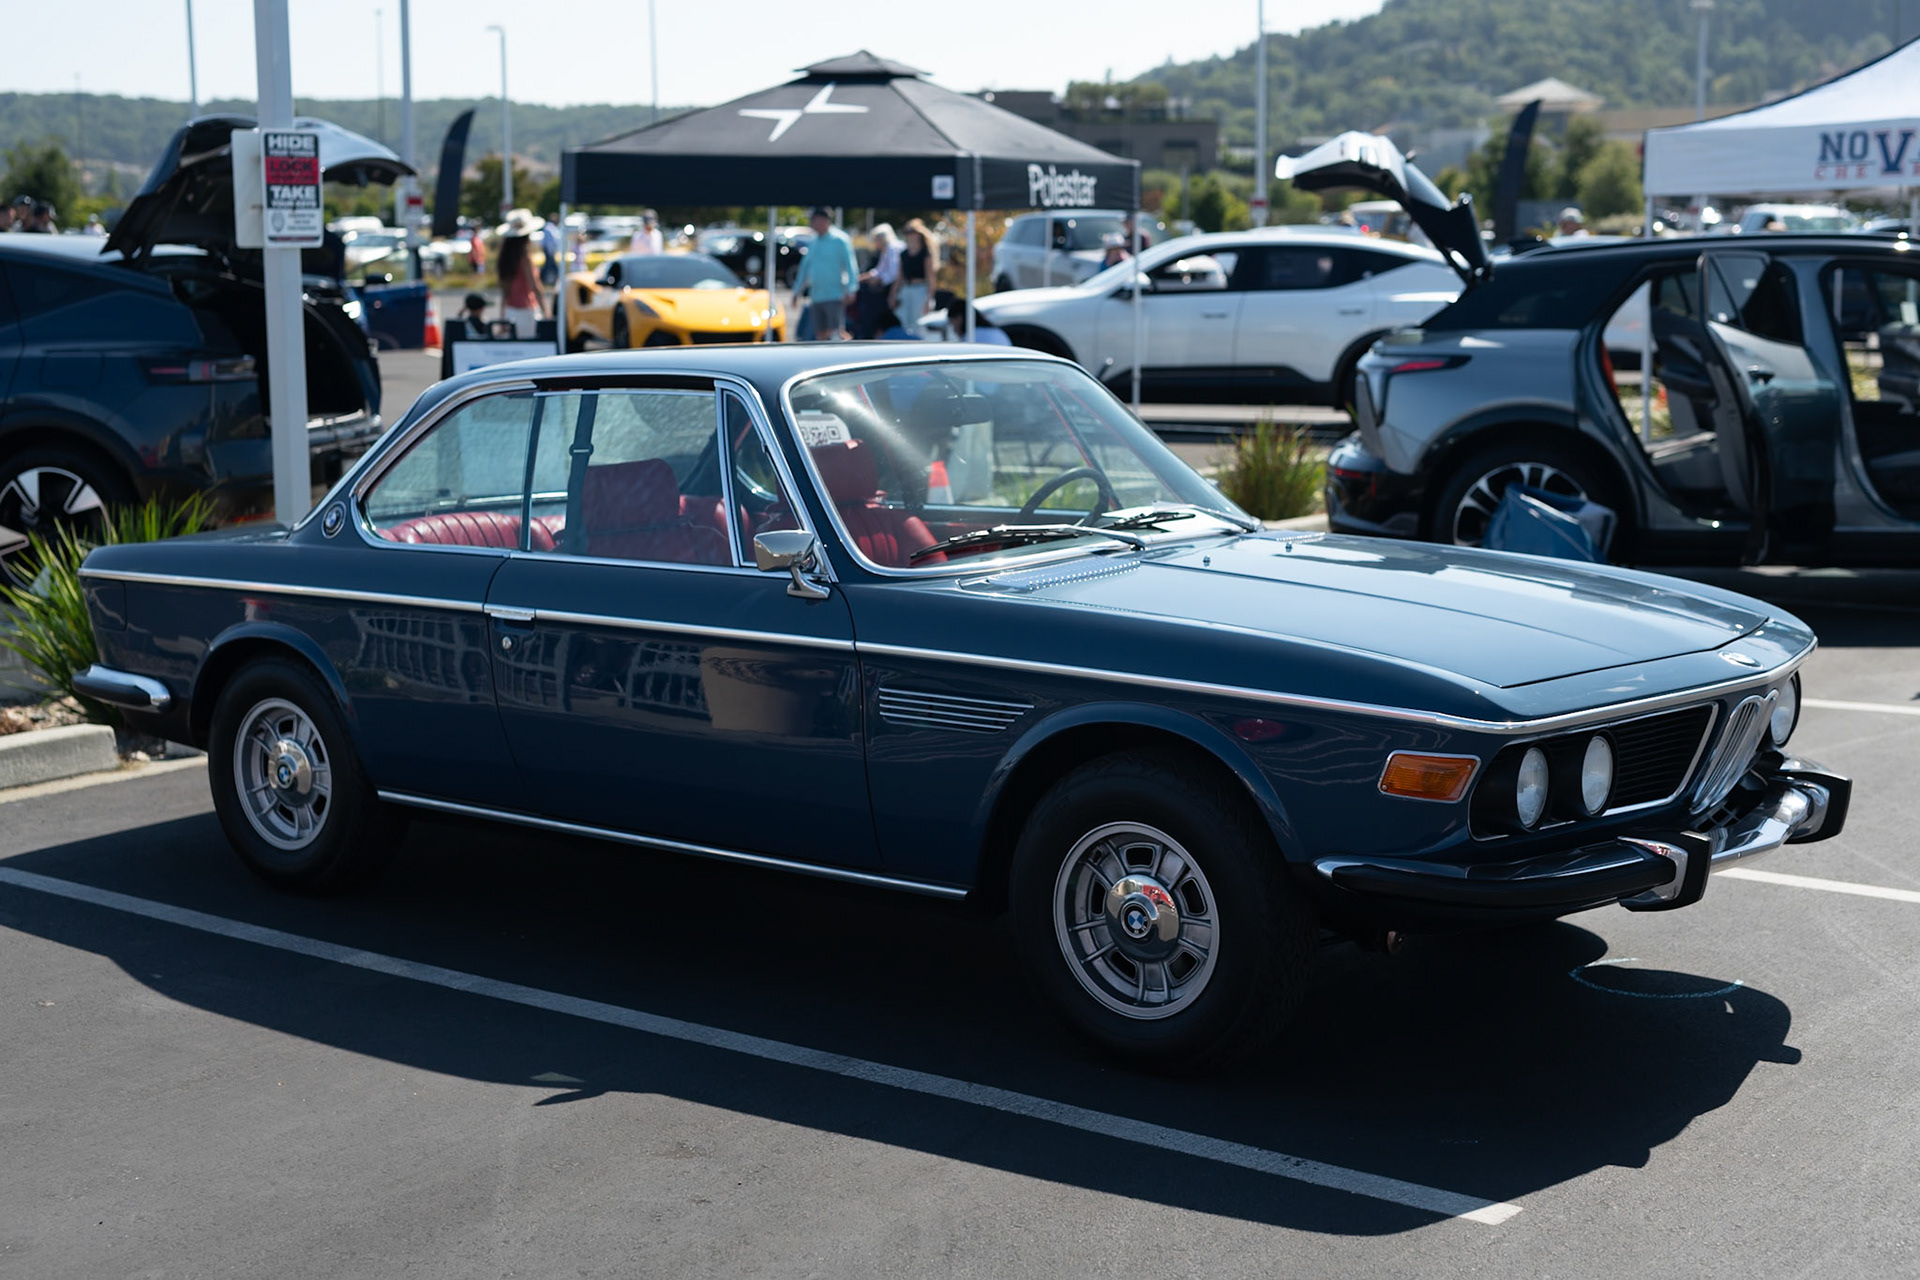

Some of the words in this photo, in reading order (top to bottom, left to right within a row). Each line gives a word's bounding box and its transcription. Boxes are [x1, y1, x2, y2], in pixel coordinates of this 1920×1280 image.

[268, 134, 316, 150] HIDE
[1819, 129, 1920, 175] NOV
[270, 160, 313, 173] LOCK
[269, 184, 316, 200] TAKE
[1027, 163, 1097, 207] Polestar
